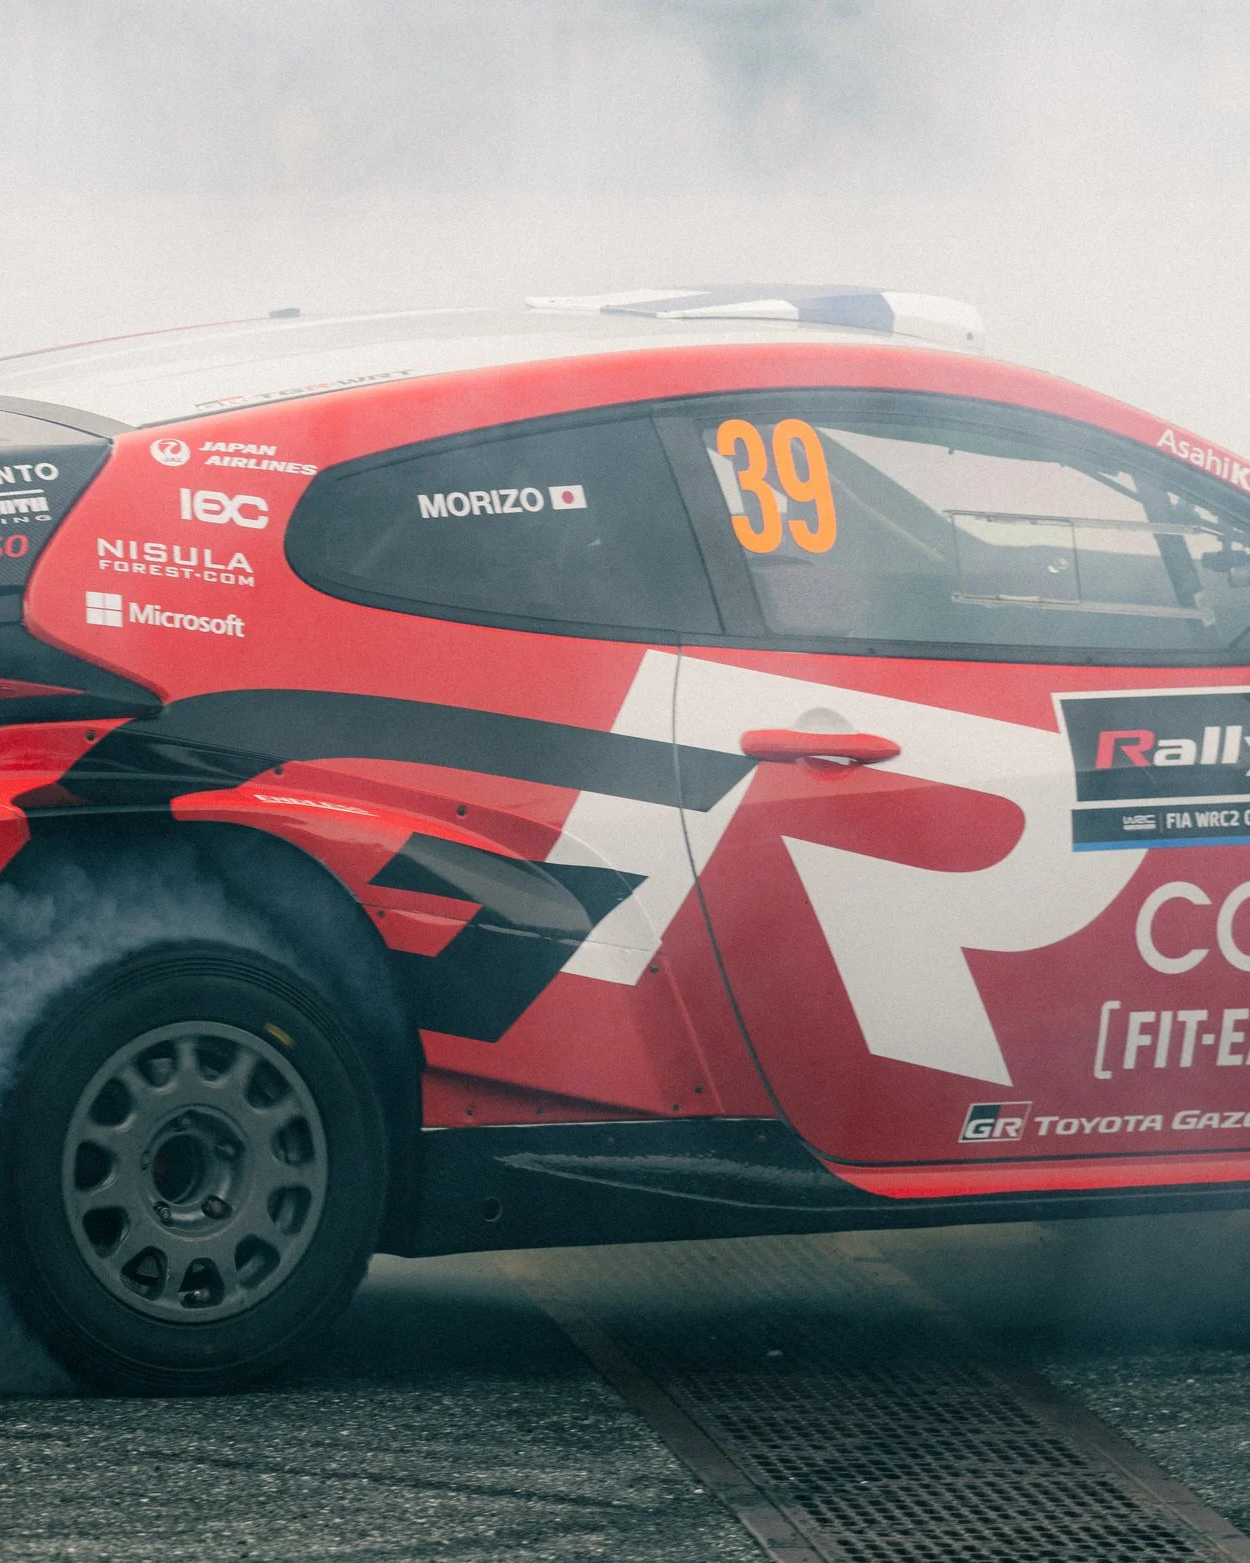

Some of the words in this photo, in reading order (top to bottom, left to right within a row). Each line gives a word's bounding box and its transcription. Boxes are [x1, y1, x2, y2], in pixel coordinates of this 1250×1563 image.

[198, 441, 277, 456] JAPAN
[204, 455, 318, 476] AIRLINES
[417, 486, 545, 519] MORIZO
[717, 419, 837, 553] 39
[97, 537, 254, 573] NISULA
[129, 601, 245, 638] Microsoft
[1095, 725, 1250, 777] Rall
[1166, 812, 1192, 829] FIA
[1195, 810, 1240, 828] WRC2
[964, 1118, 1023, 1139] GR
[1034, 1114, 1163, 1136] TOYOTA
[1171, 1110, 1250, 1130] GAZ
